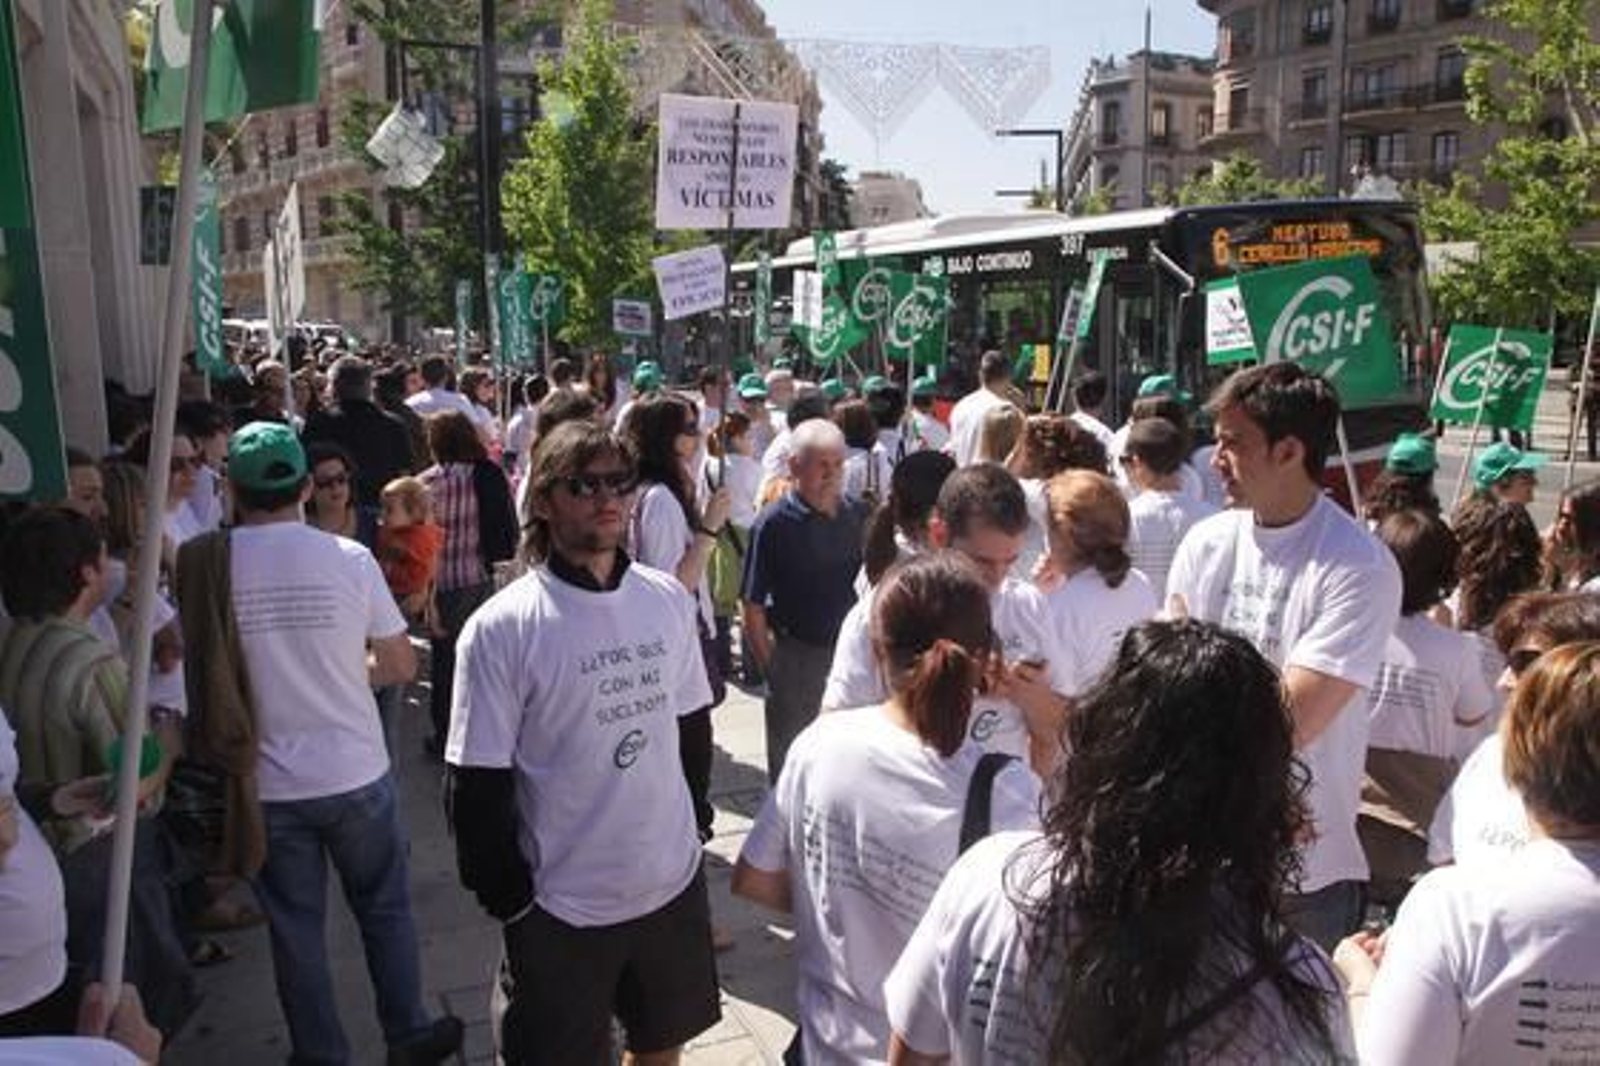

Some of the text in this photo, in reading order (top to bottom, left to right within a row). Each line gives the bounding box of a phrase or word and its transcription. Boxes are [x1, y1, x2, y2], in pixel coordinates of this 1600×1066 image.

[667, 147, 787, 169] RESPONABLES
[680, 182, 776, 209] VÍCTMAS
[1213, 227, 1230, 266] 6
[946, 256, 974, 275] BAJO
[598, 675, 634, 695] CON
